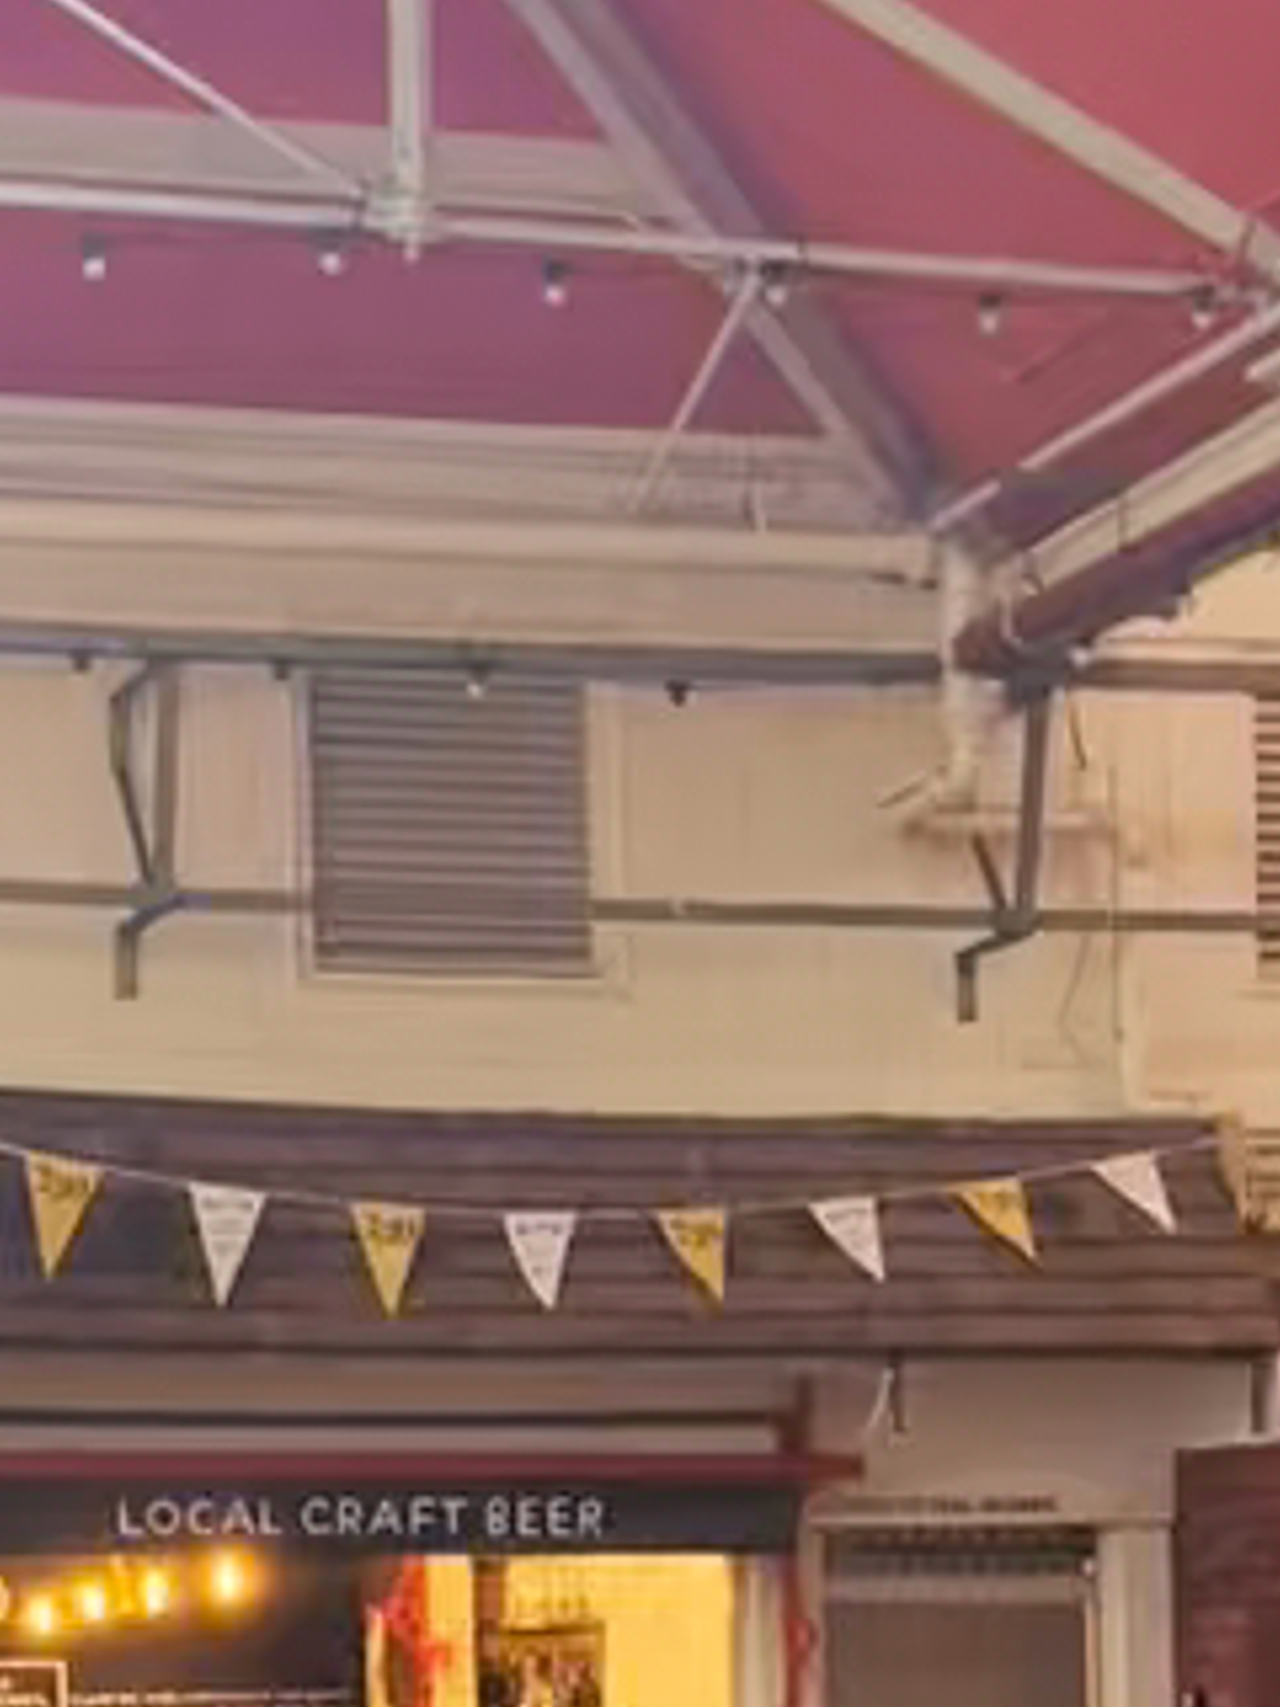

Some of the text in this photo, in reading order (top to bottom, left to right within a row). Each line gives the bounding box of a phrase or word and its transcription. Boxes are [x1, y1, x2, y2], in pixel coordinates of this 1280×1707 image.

[118, 1496, 605, 1537] LOCAL CRAFT BEER
